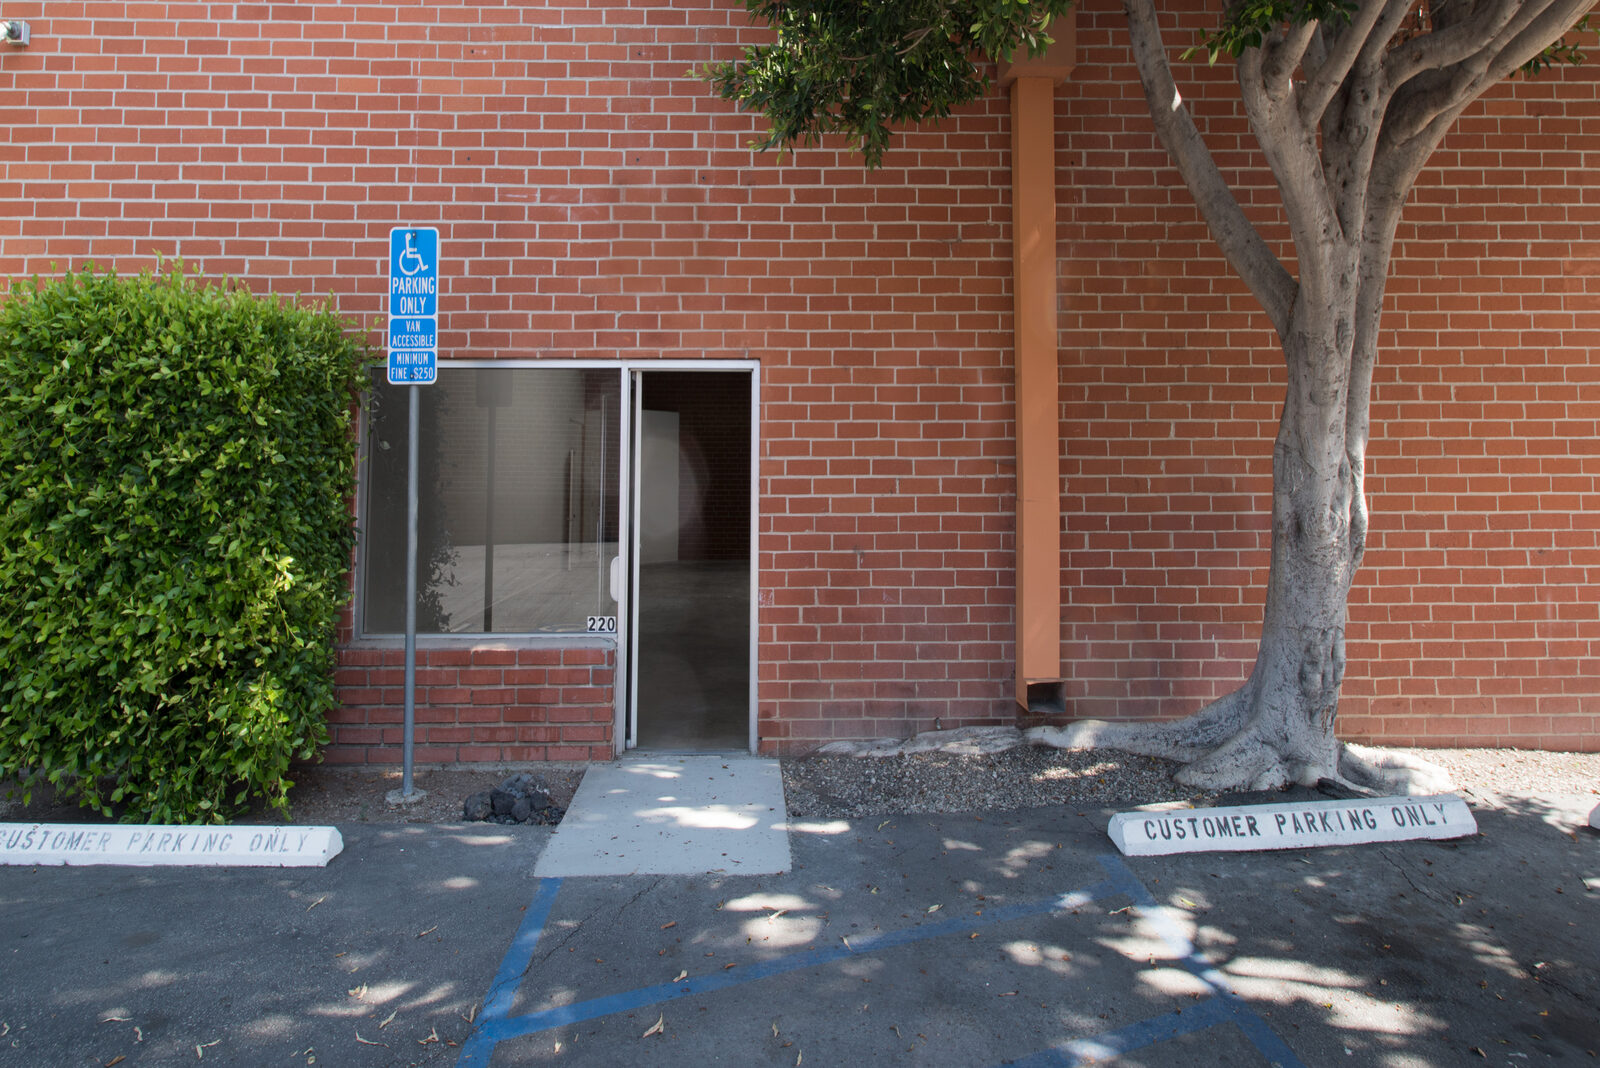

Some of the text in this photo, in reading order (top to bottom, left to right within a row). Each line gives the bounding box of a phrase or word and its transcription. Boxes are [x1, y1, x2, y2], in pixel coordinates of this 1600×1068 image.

[392, 277, 435, 294] PARKING
[400, 296, 427, 314] ONLY
[405, 320, 421, 332] VAN
[391, 335, 434, 347] ACCESSIBLE
[396, 353, 429, 365] MINIMUM
[391, 367, 434, 379] FINE $250
[588, 617, 615, 631] 220
[1144, 803, 1449, 841] CUSTOMER PARKING ONLY
[128, 832, 233, 853] PARKING
[249, 832, 311, 852] ONLY
